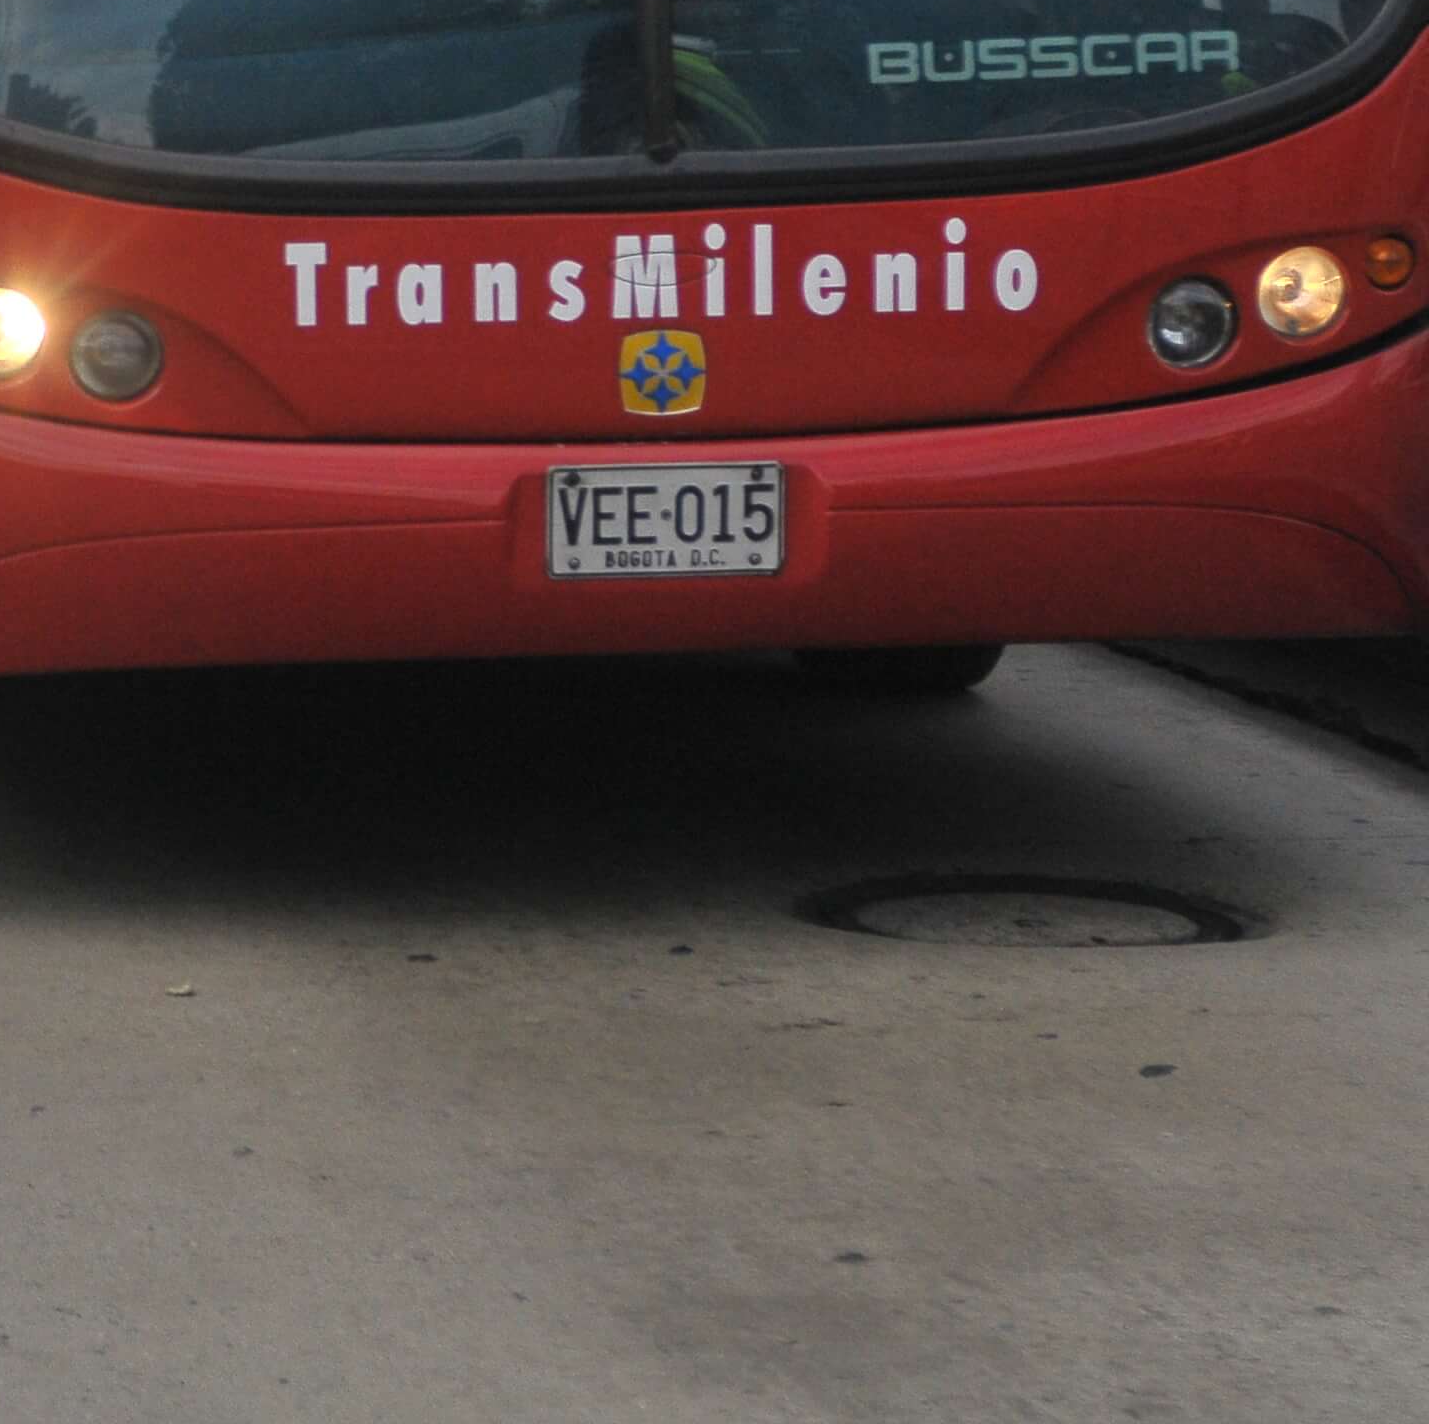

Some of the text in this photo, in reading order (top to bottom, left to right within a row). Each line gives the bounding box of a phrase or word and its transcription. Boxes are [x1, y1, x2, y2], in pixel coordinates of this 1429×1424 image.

[868, 30, 1239, 84] BUSSCAR
[285, 217, 1039, 327] TransMilenio
[604, 548, 727, 568] BOGOTA D.C.
